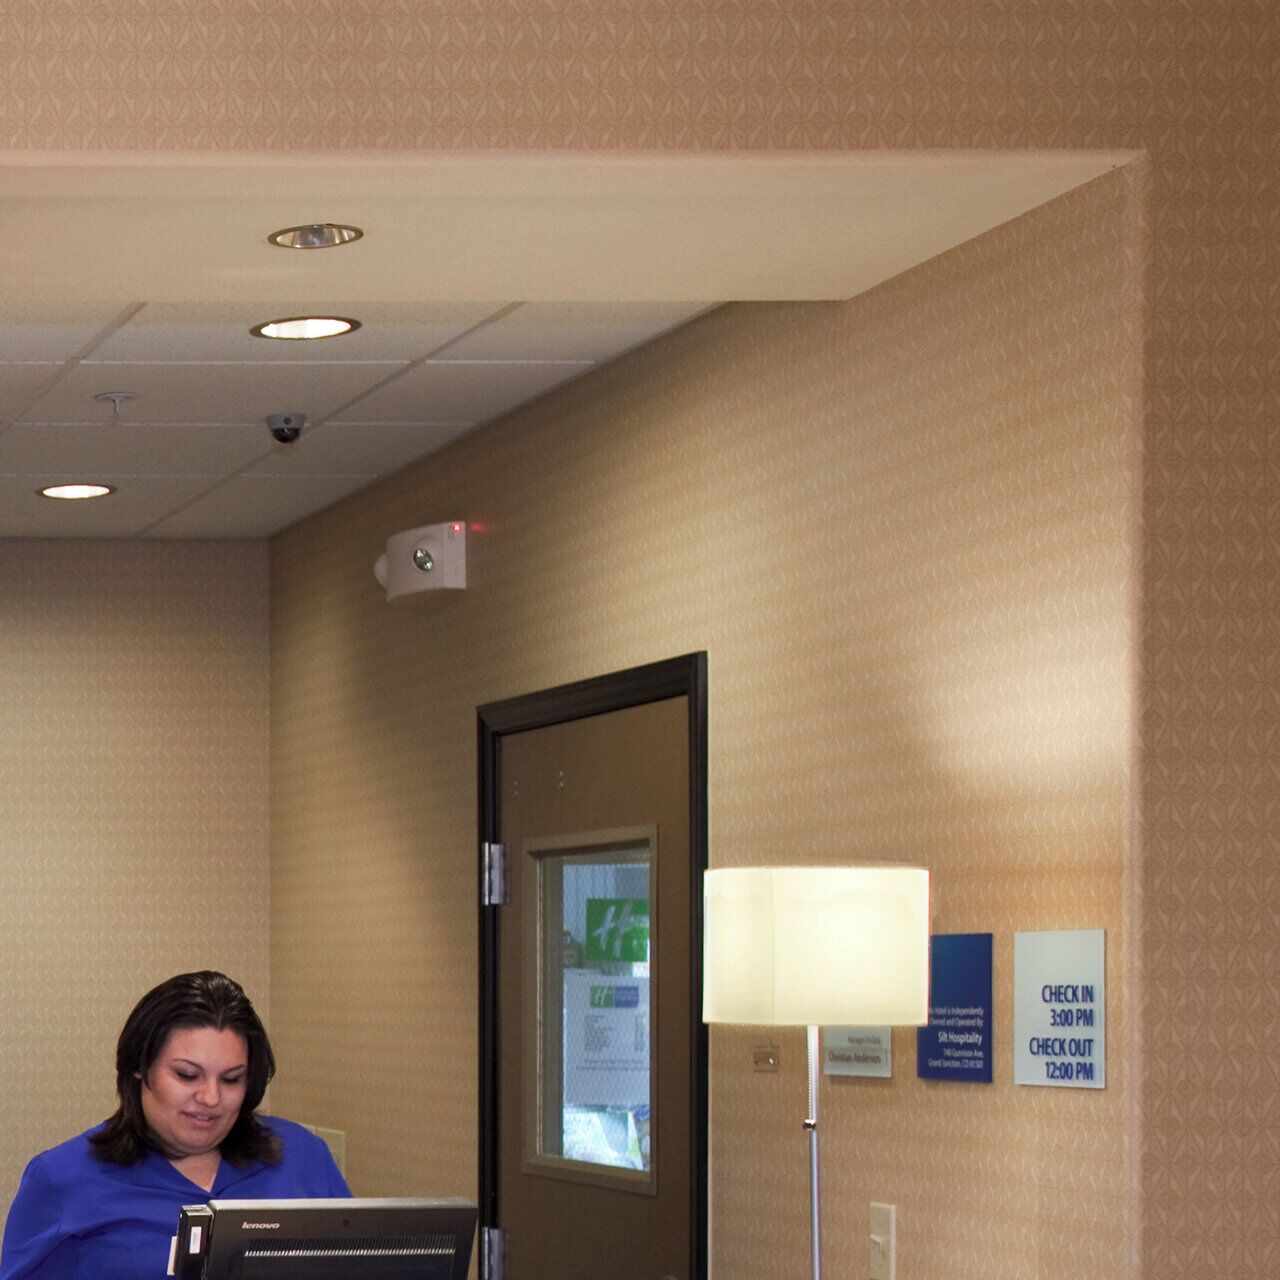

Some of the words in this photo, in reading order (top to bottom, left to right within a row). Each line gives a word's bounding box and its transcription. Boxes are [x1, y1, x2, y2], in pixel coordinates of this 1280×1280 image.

[1041, 984, 1080, 1004] CHECK
[1081, 984, 1094, 1003] IN
[1049, 1008, 1074, 1028] 3:00
[1075, 1008, 1094, 1028] PM
[949, 1032, 983, 1046] Hospitality
[1029, 1037, 1067, 1056] CHECK
[1068, 1038, 1094, 1057] OUT
[1045, 1061, 1074, 1080] 12:00
[1075, 1062, 1094, 1080] PM
[241, 1221, 281, 1229] lenovo
